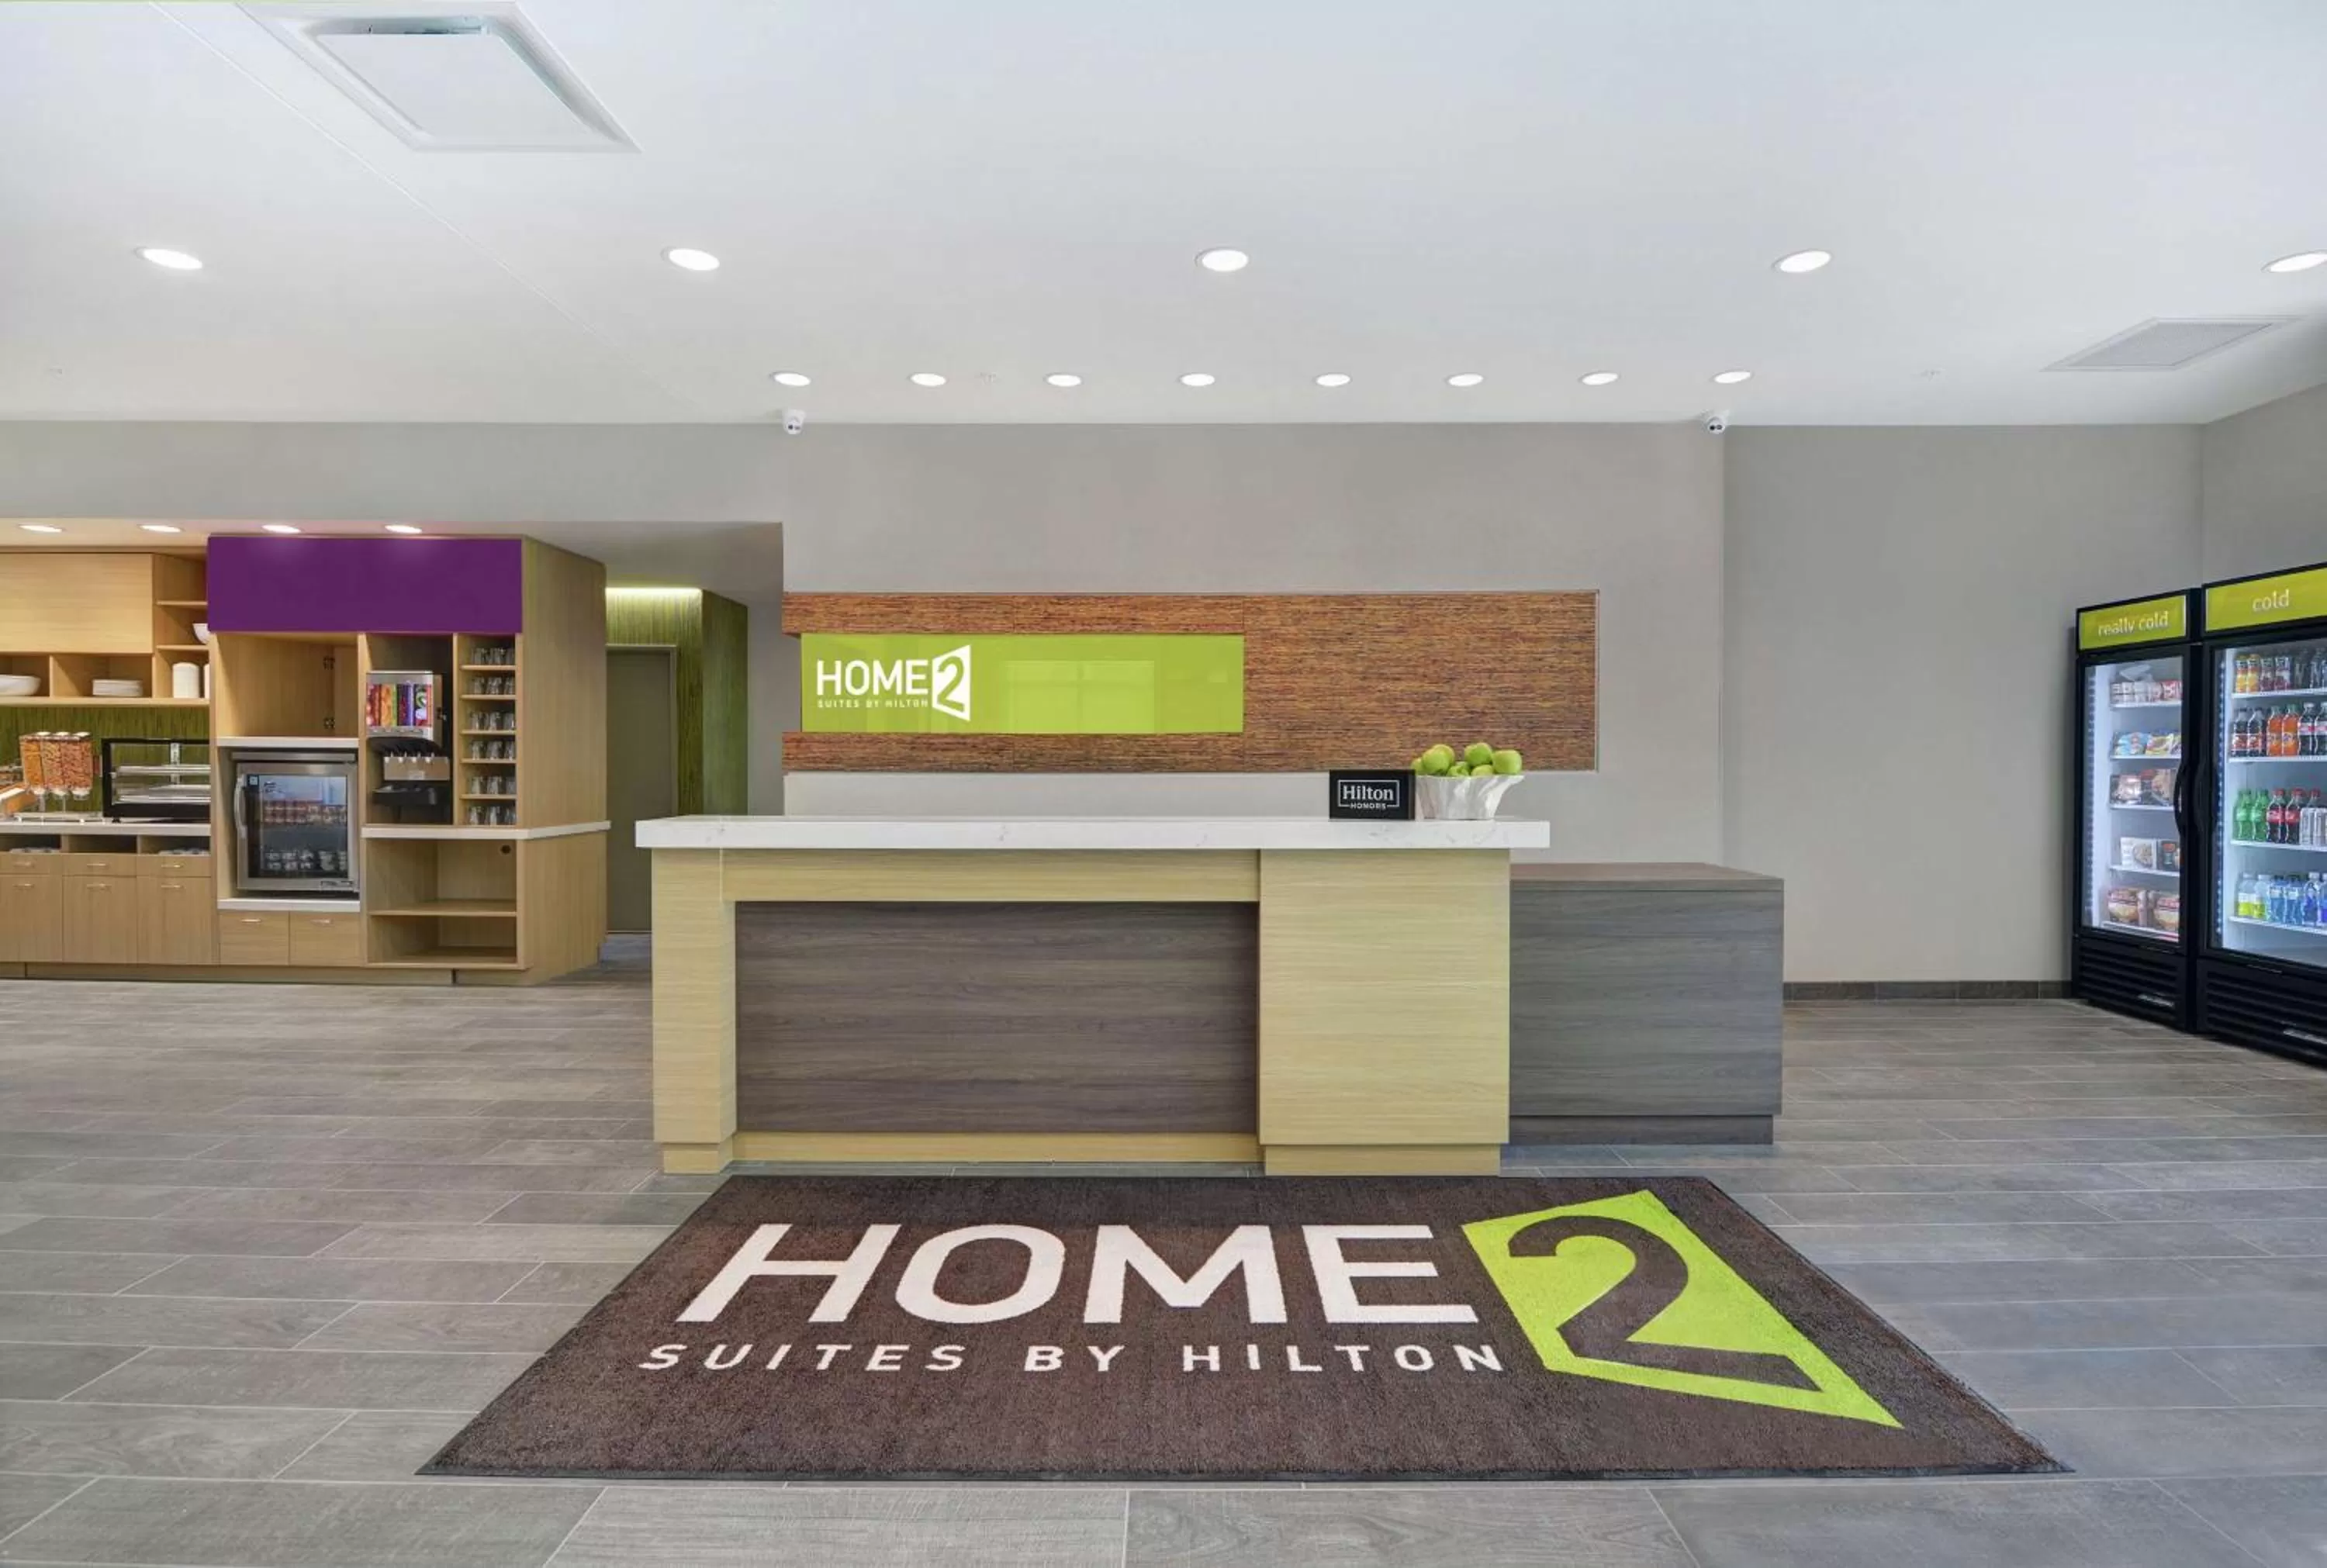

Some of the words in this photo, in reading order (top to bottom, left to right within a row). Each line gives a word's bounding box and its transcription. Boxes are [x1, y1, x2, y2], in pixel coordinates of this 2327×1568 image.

[2252, 589, 2290, 612] cold
[2097, 616, 2134, 637] really
[2138, 610, 2170, 631] cold
[818, 699, 859, 708] SUITES
[866, 699, 880, 708] BY
[885, 699, 928, 708] HILTON
[1343, 785, 1394, 801] Hilton
[639, 1344, 966, 1371] SUITES
[1025, 1345, 1125, 1372] BY
[1184, 1344, 1503, 1372] HILTON
